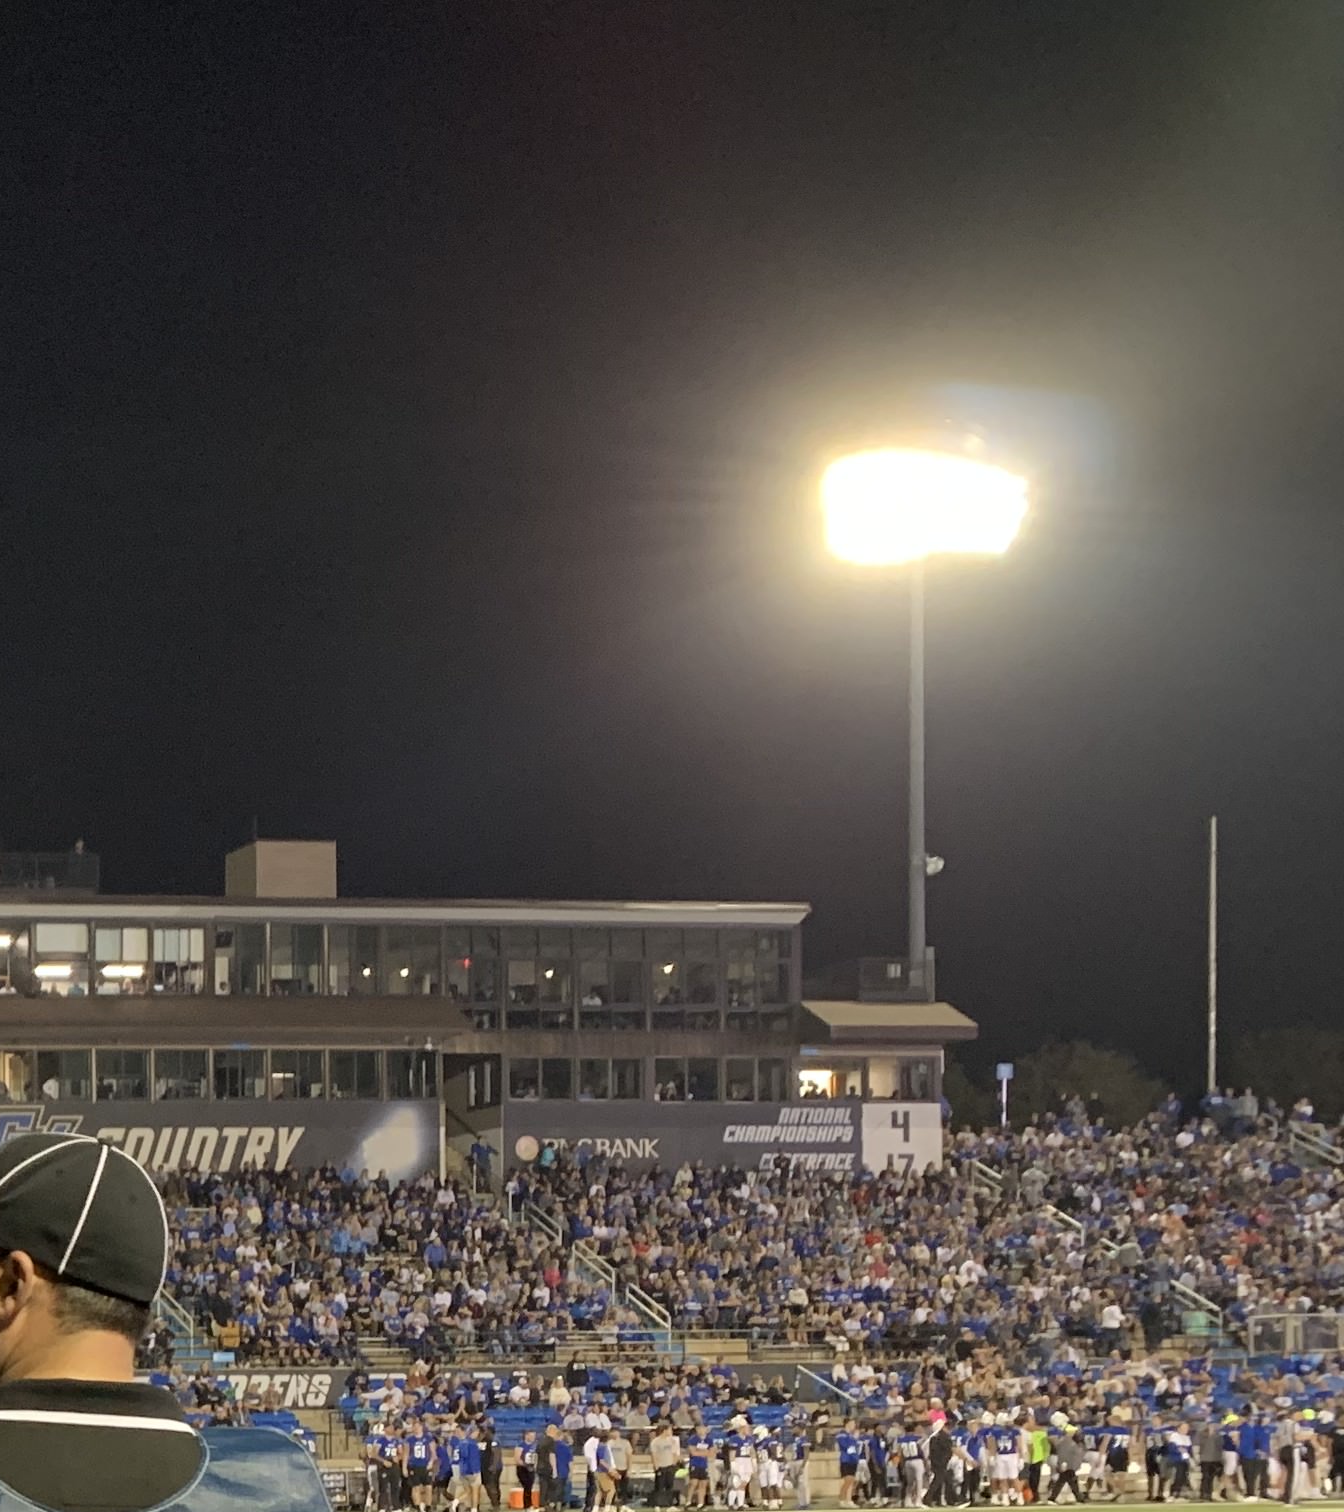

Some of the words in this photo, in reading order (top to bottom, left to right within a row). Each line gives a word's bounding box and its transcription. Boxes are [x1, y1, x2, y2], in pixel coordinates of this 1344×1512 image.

[778, 1107, 852, 1124] NATIONAL
[723, 1125, 854, 1143] CHAMPIONSHIPS
[891, 1110, 910, 1143] 4
[594, 1137, 660, 1158] BANK
[759, 1153, 856, 1171] COFERENCE
